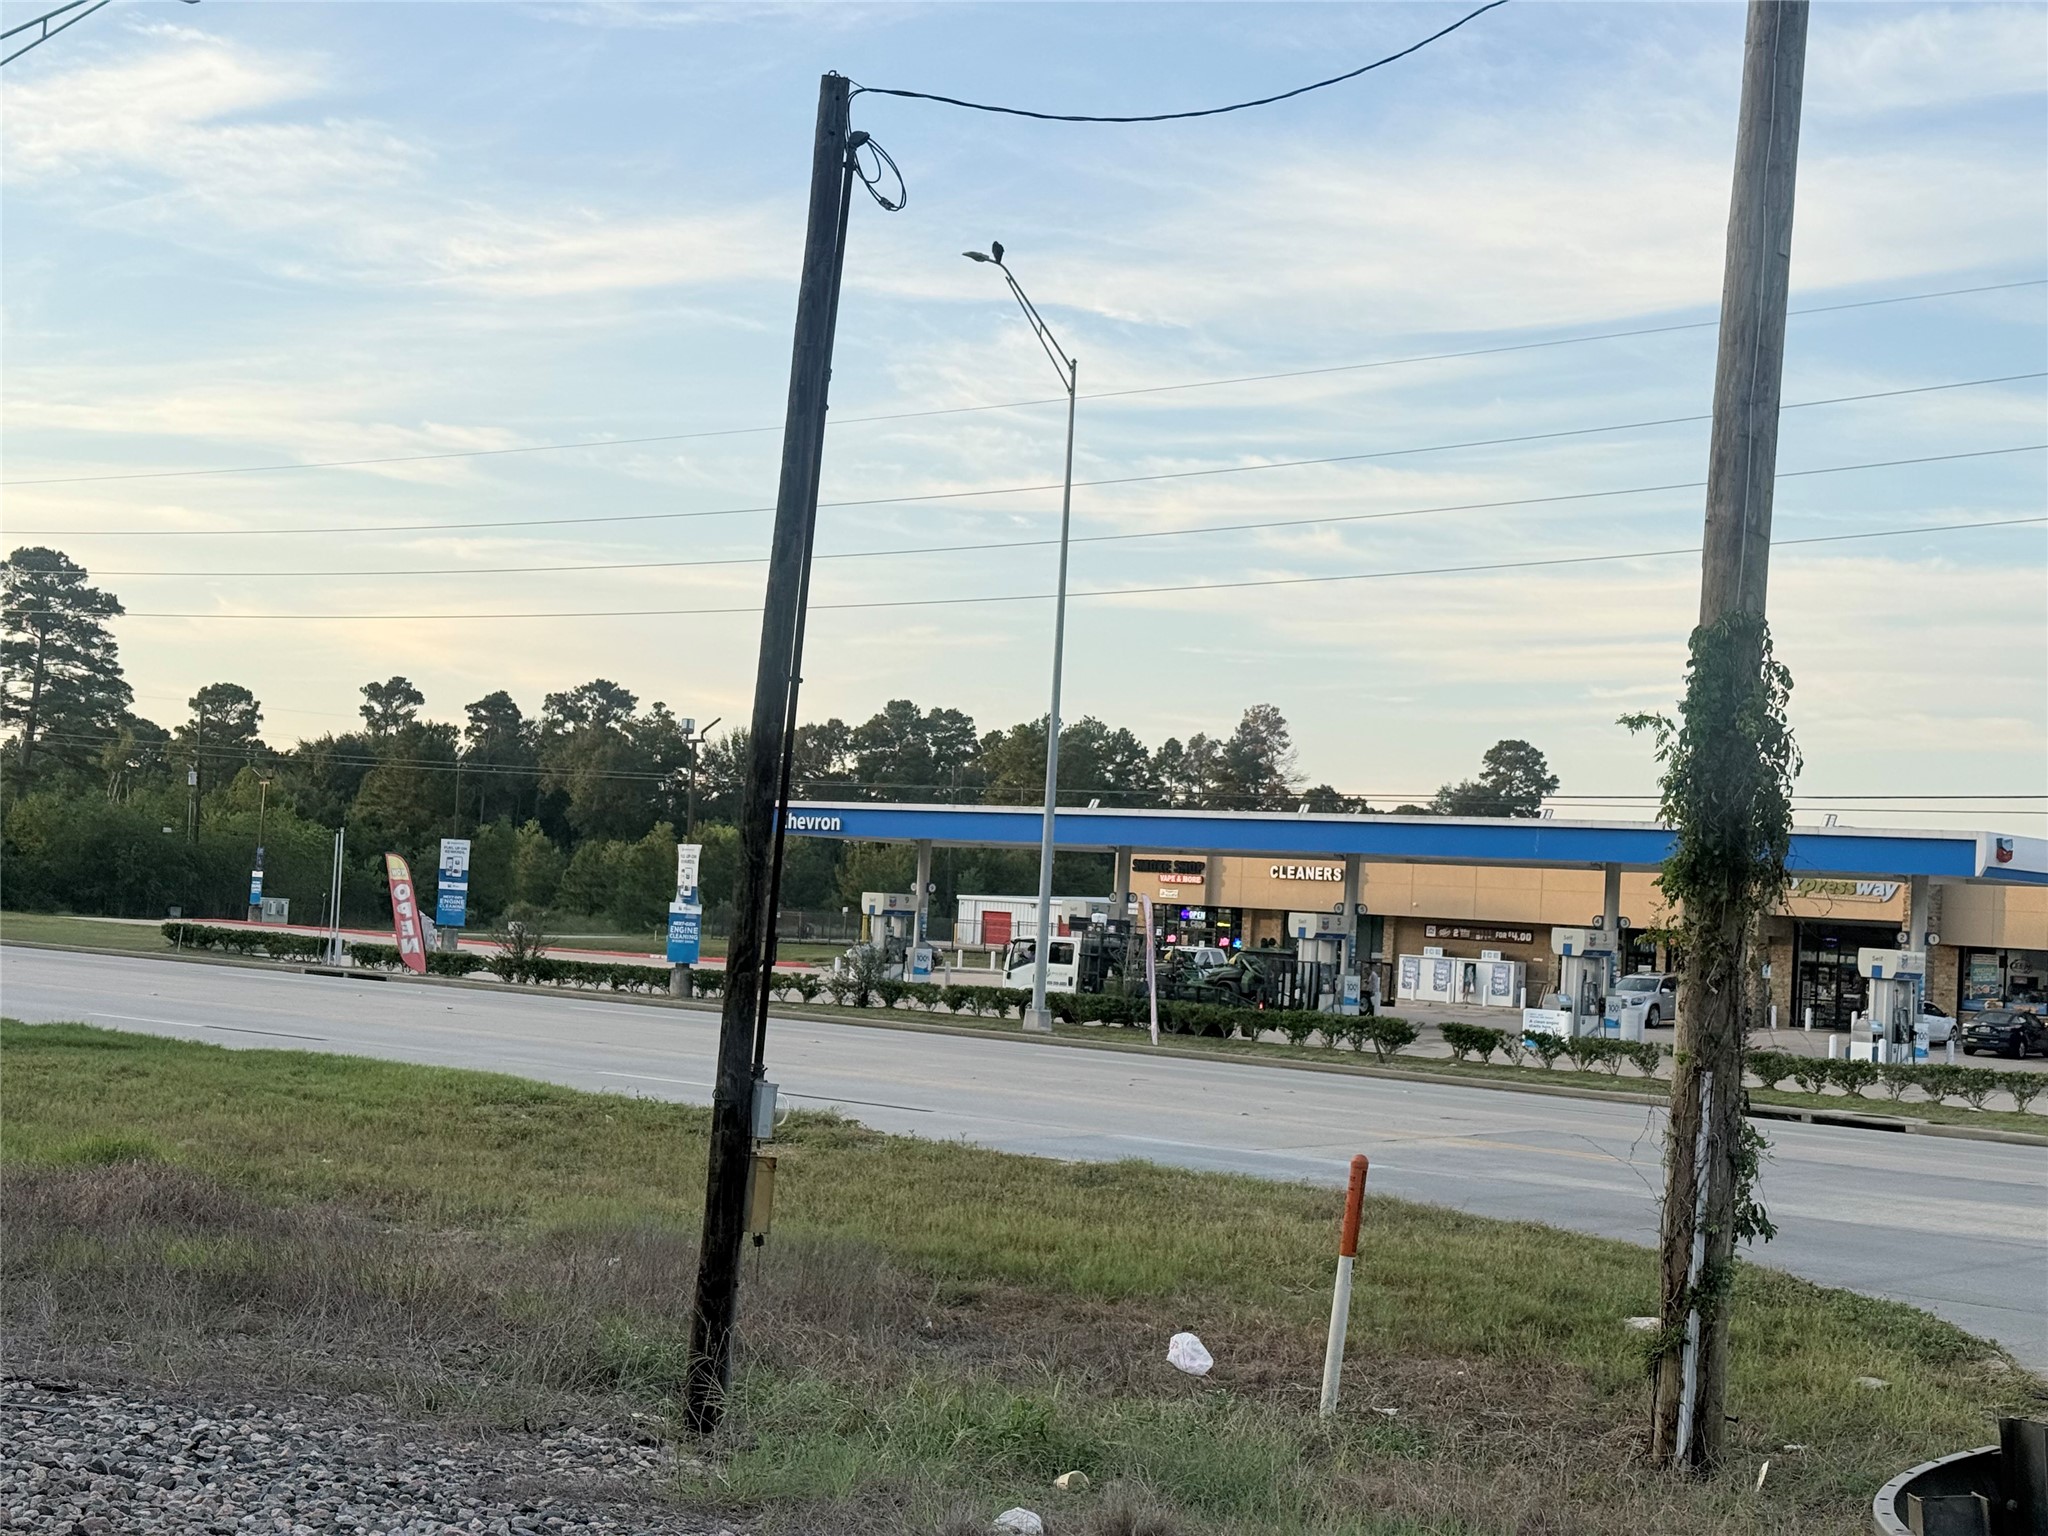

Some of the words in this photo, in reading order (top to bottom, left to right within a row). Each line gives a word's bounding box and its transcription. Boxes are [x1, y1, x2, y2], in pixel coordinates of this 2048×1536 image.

[785, 812, 841, 831] hevron
[1269, 865, 1343, 881] CLEANERS
[1160, 874, 1176, 883] VAPE
[1183, 876, 1202, 884] MORE
[1189, 910, 1206, 920] OPEN
[670, 925, 699, 934] ENGINE
[1452, 928, 1459, 937] 2
[1495, 931, 1507, 939] FOR
[1425, 948, 1442, 956] ICE
[1482, 951, 1500, 959] ICE
